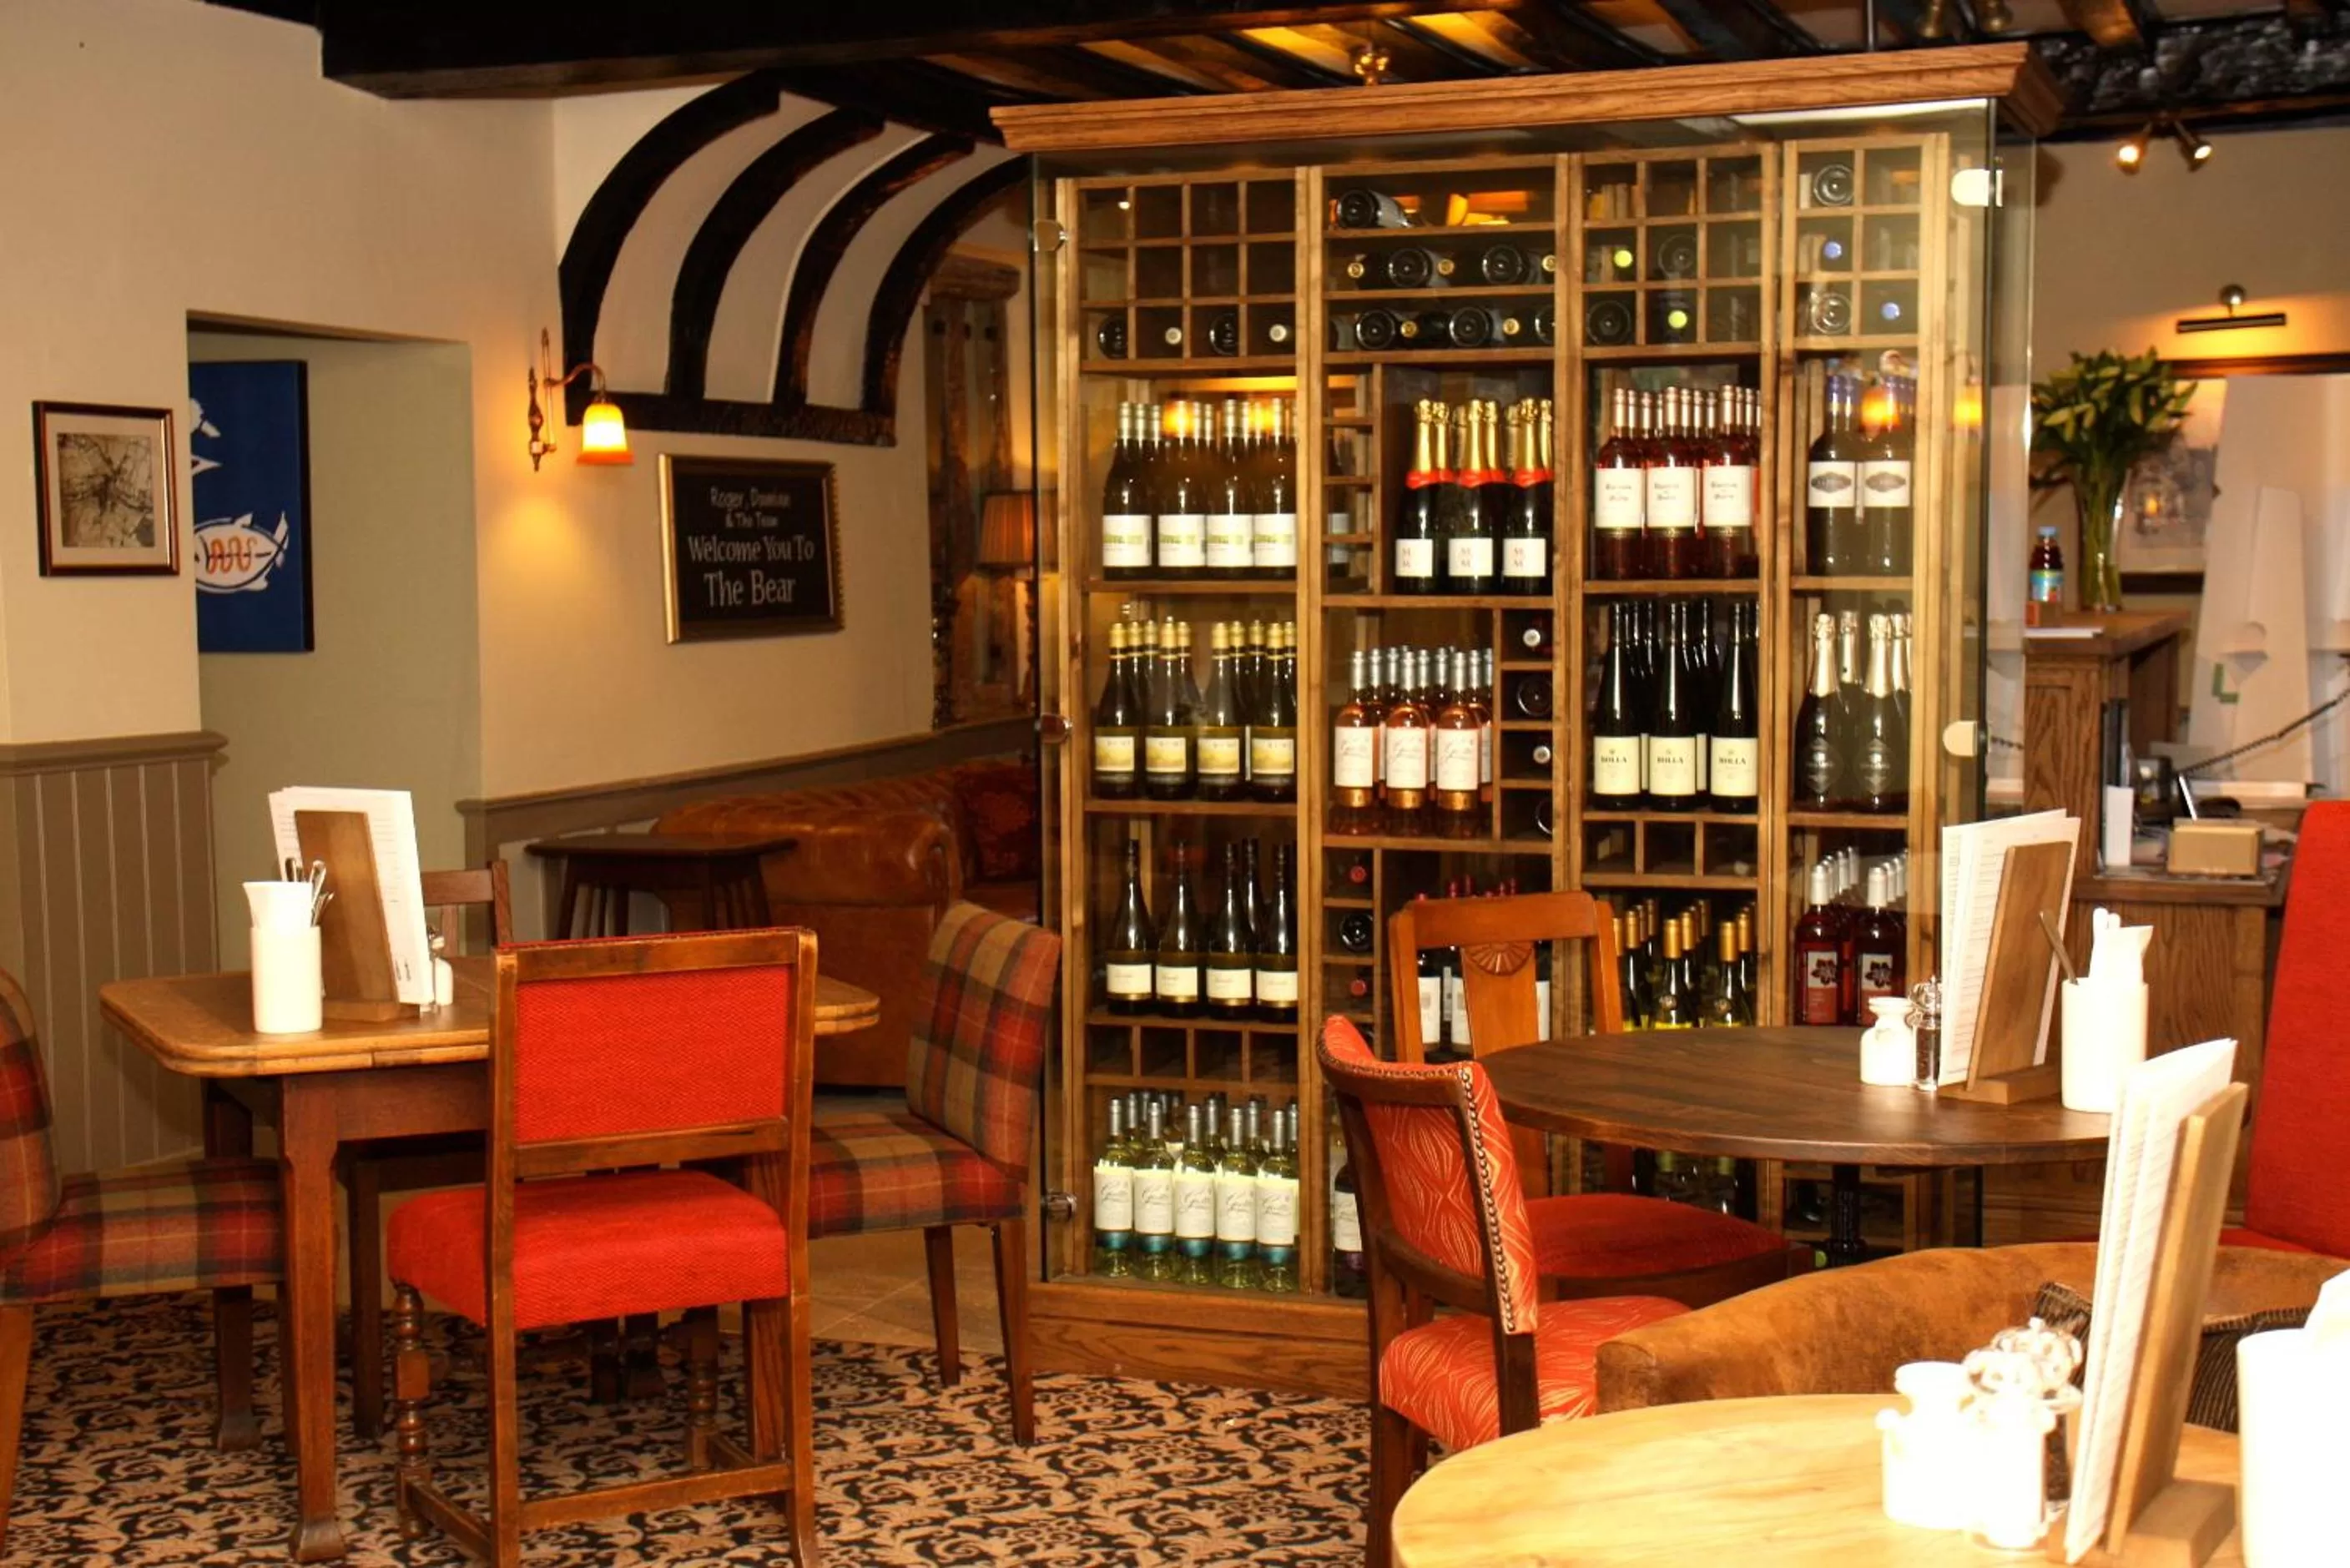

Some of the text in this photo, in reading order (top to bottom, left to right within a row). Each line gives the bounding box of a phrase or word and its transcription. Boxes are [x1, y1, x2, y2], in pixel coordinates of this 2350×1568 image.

[734, 512, 753, 527] The
[688, 533, 815, 562] Welcome You To
[703, 569, 796, 608] The Bear
